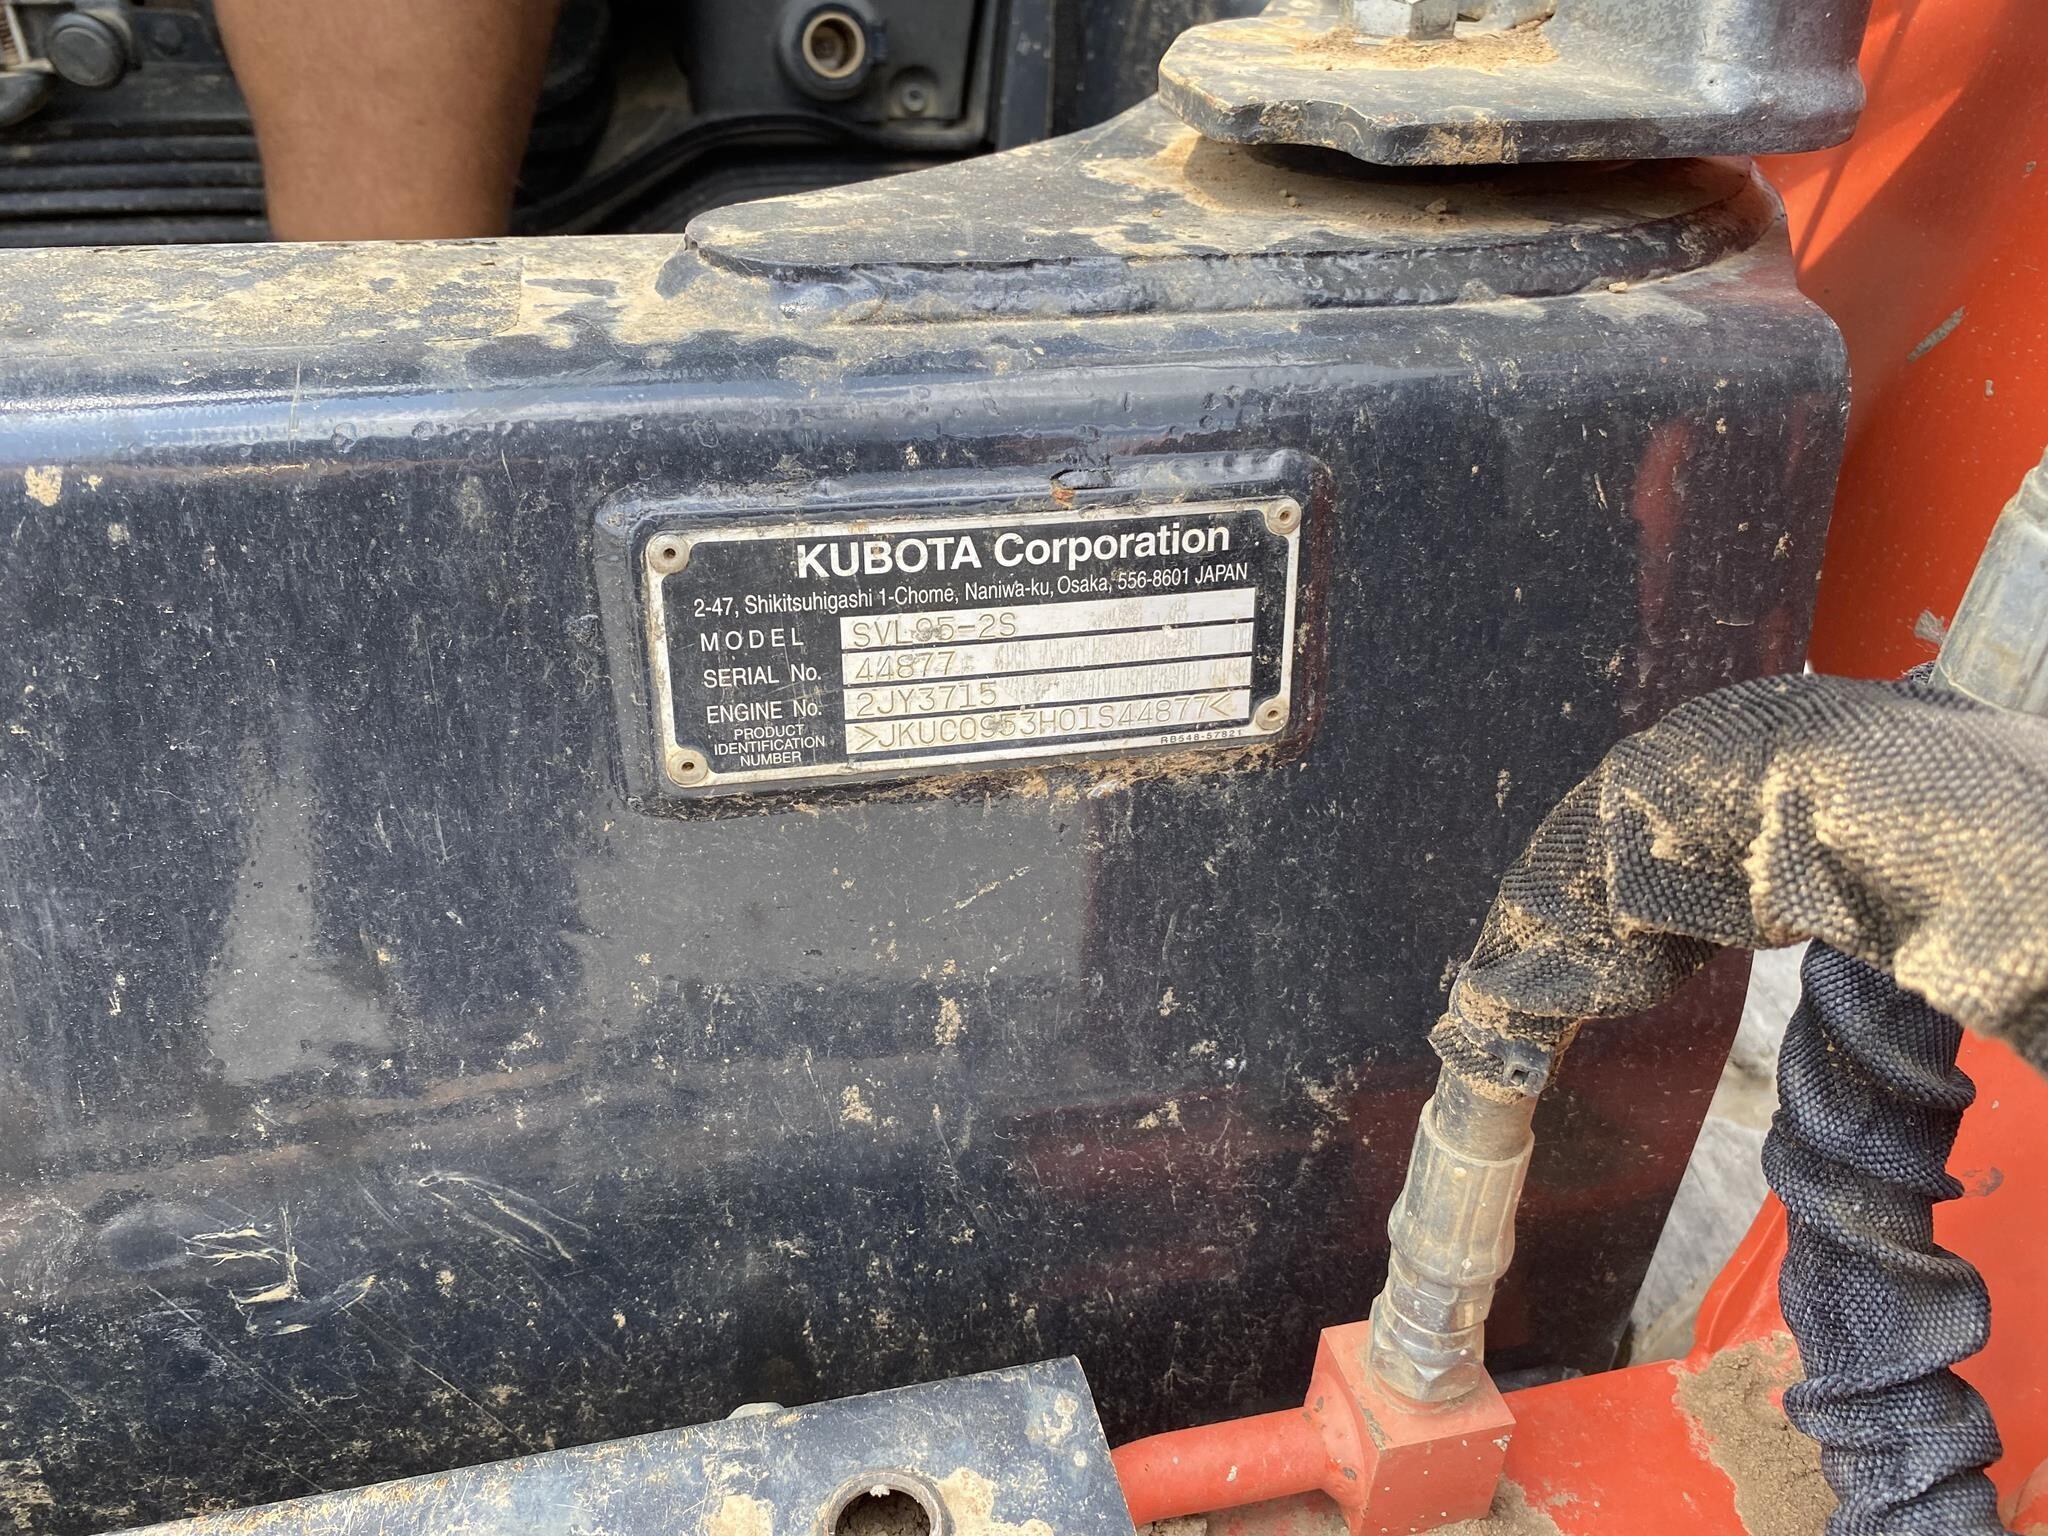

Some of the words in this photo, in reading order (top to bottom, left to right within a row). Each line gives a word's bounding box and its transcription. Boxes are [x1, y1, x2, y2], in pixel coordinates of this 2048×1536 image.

[797, 535, 982, 578] KUBOTA
[994, 522, 1230, 571] Corporation
[693, 597, 739, 618] 2-47,
[744, 589, 873, 615] Shikitsuhigashi
[879, 585, 959, 606] 1-Chome,
[964, 580, 1054, 601] Naniwa-ku,
[1057, 574, 1113, 595] Osaka,
[1117, 568, 1189, 590] 556-8601
[1195, 563, 1248, 584] JAPAN
[700, 627, 804, 651] MODEL
[703, 665, 780, 689] SERIAL
[791, 664, 822, 682] No.
[855, 651, 957, 681] 44877
[706, 700, 783, 724] ENGINE
[793, 699, 822, 717] No.
[857, 681, 997, 717] 2JY3715
[734, 723, 805, 740] PRODUCT
[714, 735, 825, 756] IDENTIFICATION
[740, 751, 802, 767] NUMBER
